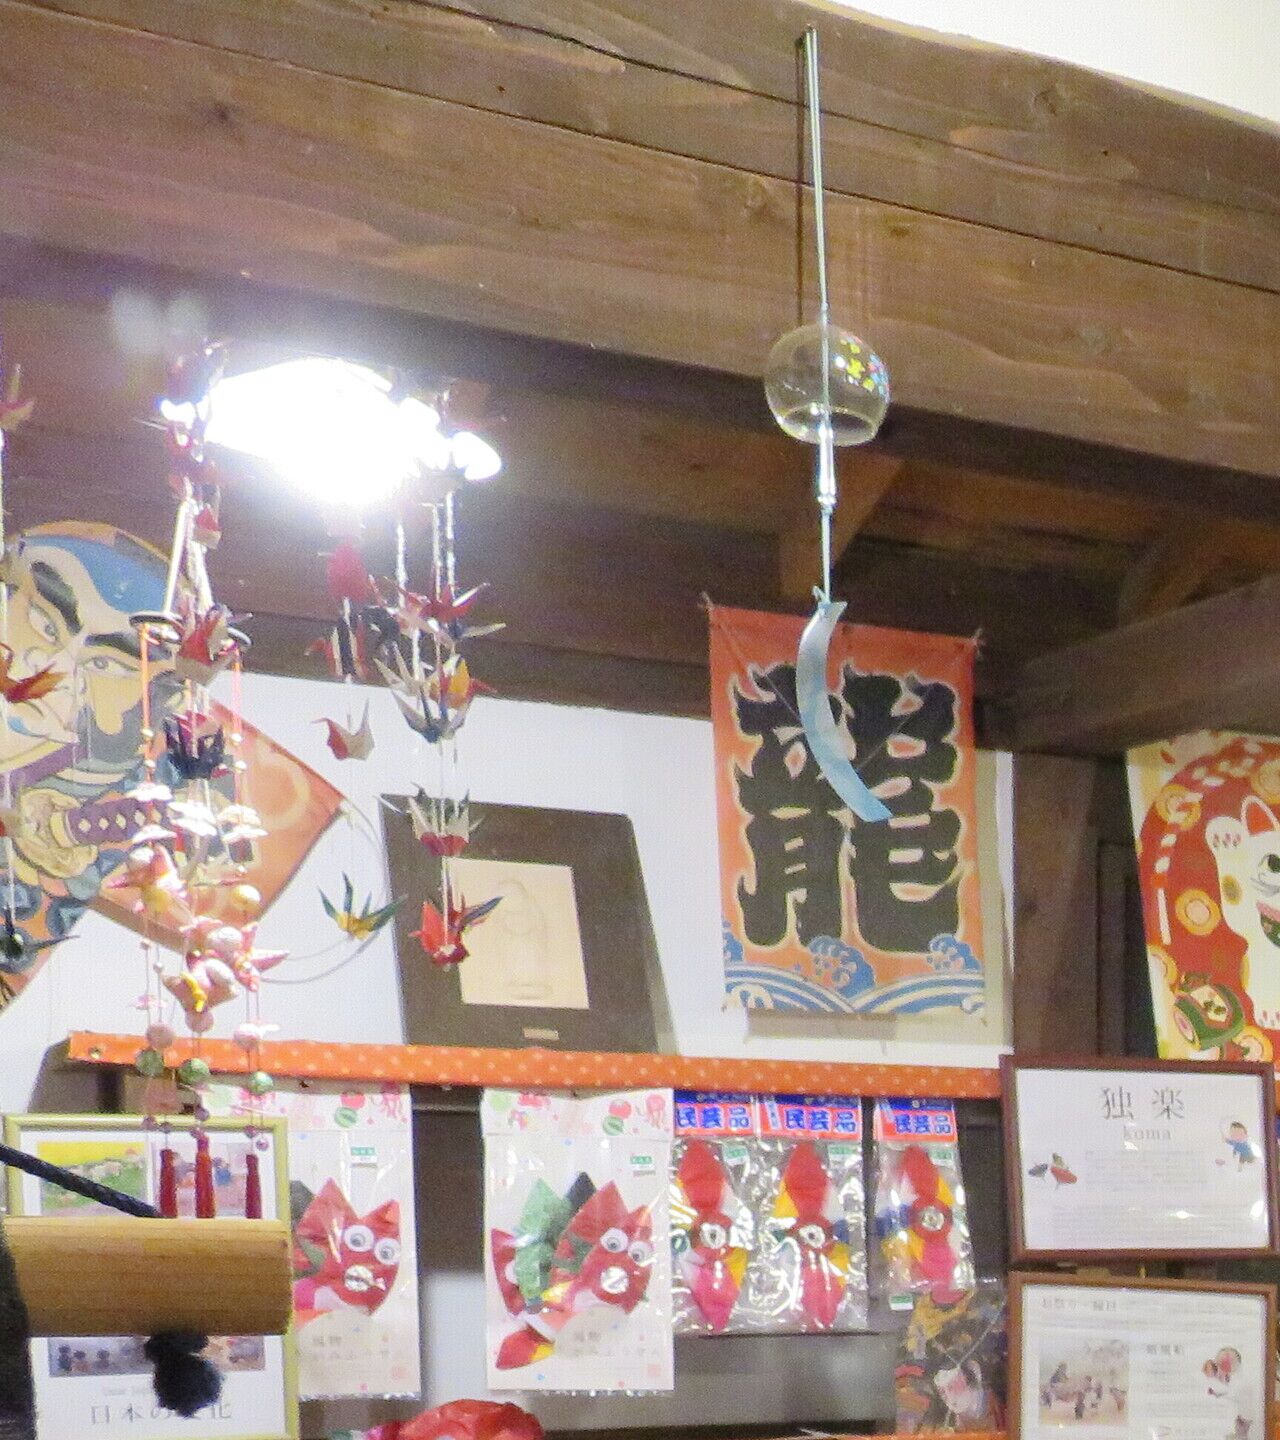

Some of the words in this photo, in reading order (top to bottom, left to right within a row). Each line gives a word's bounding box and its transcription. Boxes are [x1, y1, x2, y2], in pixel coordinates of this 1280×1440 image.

[1103, 1086, 1184, 1120] 独楽
[677, 1105, 750, 1129] 民芸品
[785, 1108, 856, 1133] 民芸品
[1123, 1124, 1171, 1141] koma
[91, 1404, 232, 1426] 日本の化
